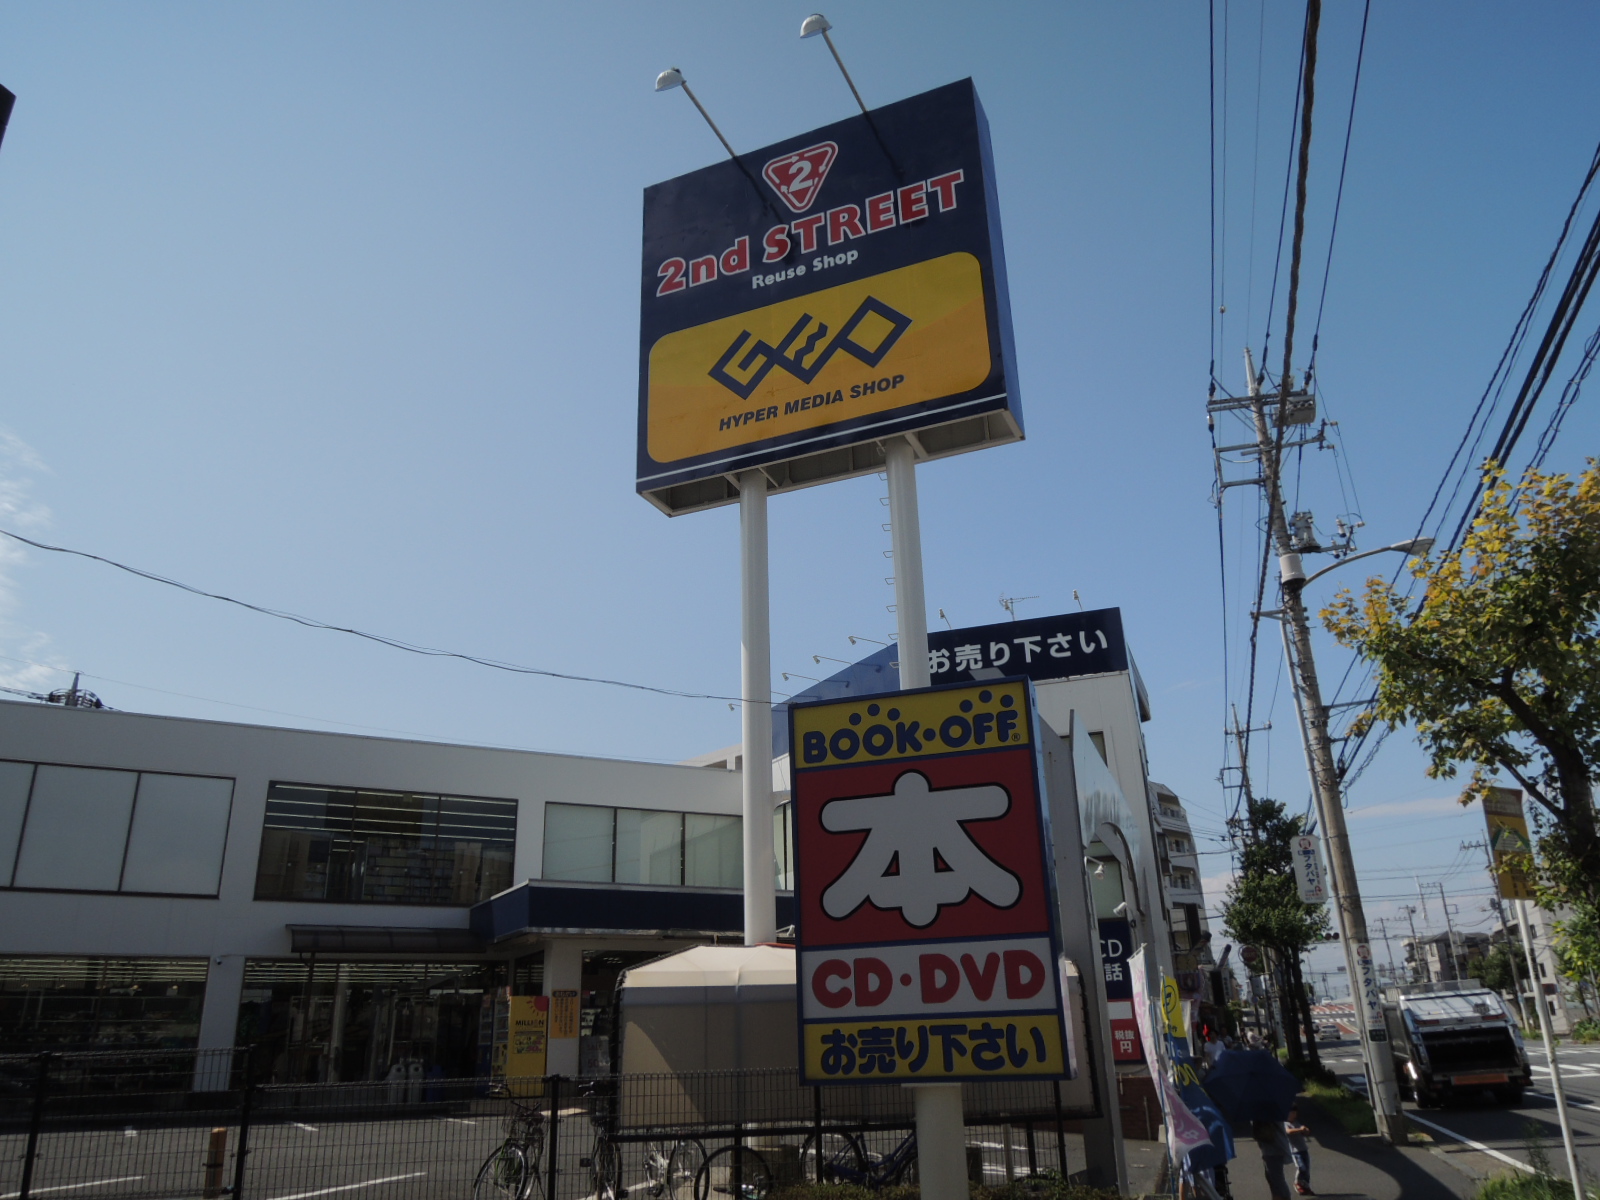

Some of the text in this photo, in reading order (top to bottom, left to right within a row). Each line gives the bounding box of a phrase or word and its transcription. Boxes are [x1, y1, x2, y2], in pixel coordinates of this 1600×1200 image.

[656, 169, 964, 297] 2nd STREET
[751, 249, 859, 289] Reuse Shop
[707, 295, 913, 400] GEO
[719, 374, 905, 431] HYPER MEDIA SHOP
[928, 629, 1108, 674] お売り下さい
[819, 769, 1024, 928] 本
[820, 1022, 1047, 1075] お売り下さい
[1120, 1040, 1133, 1053] 円
